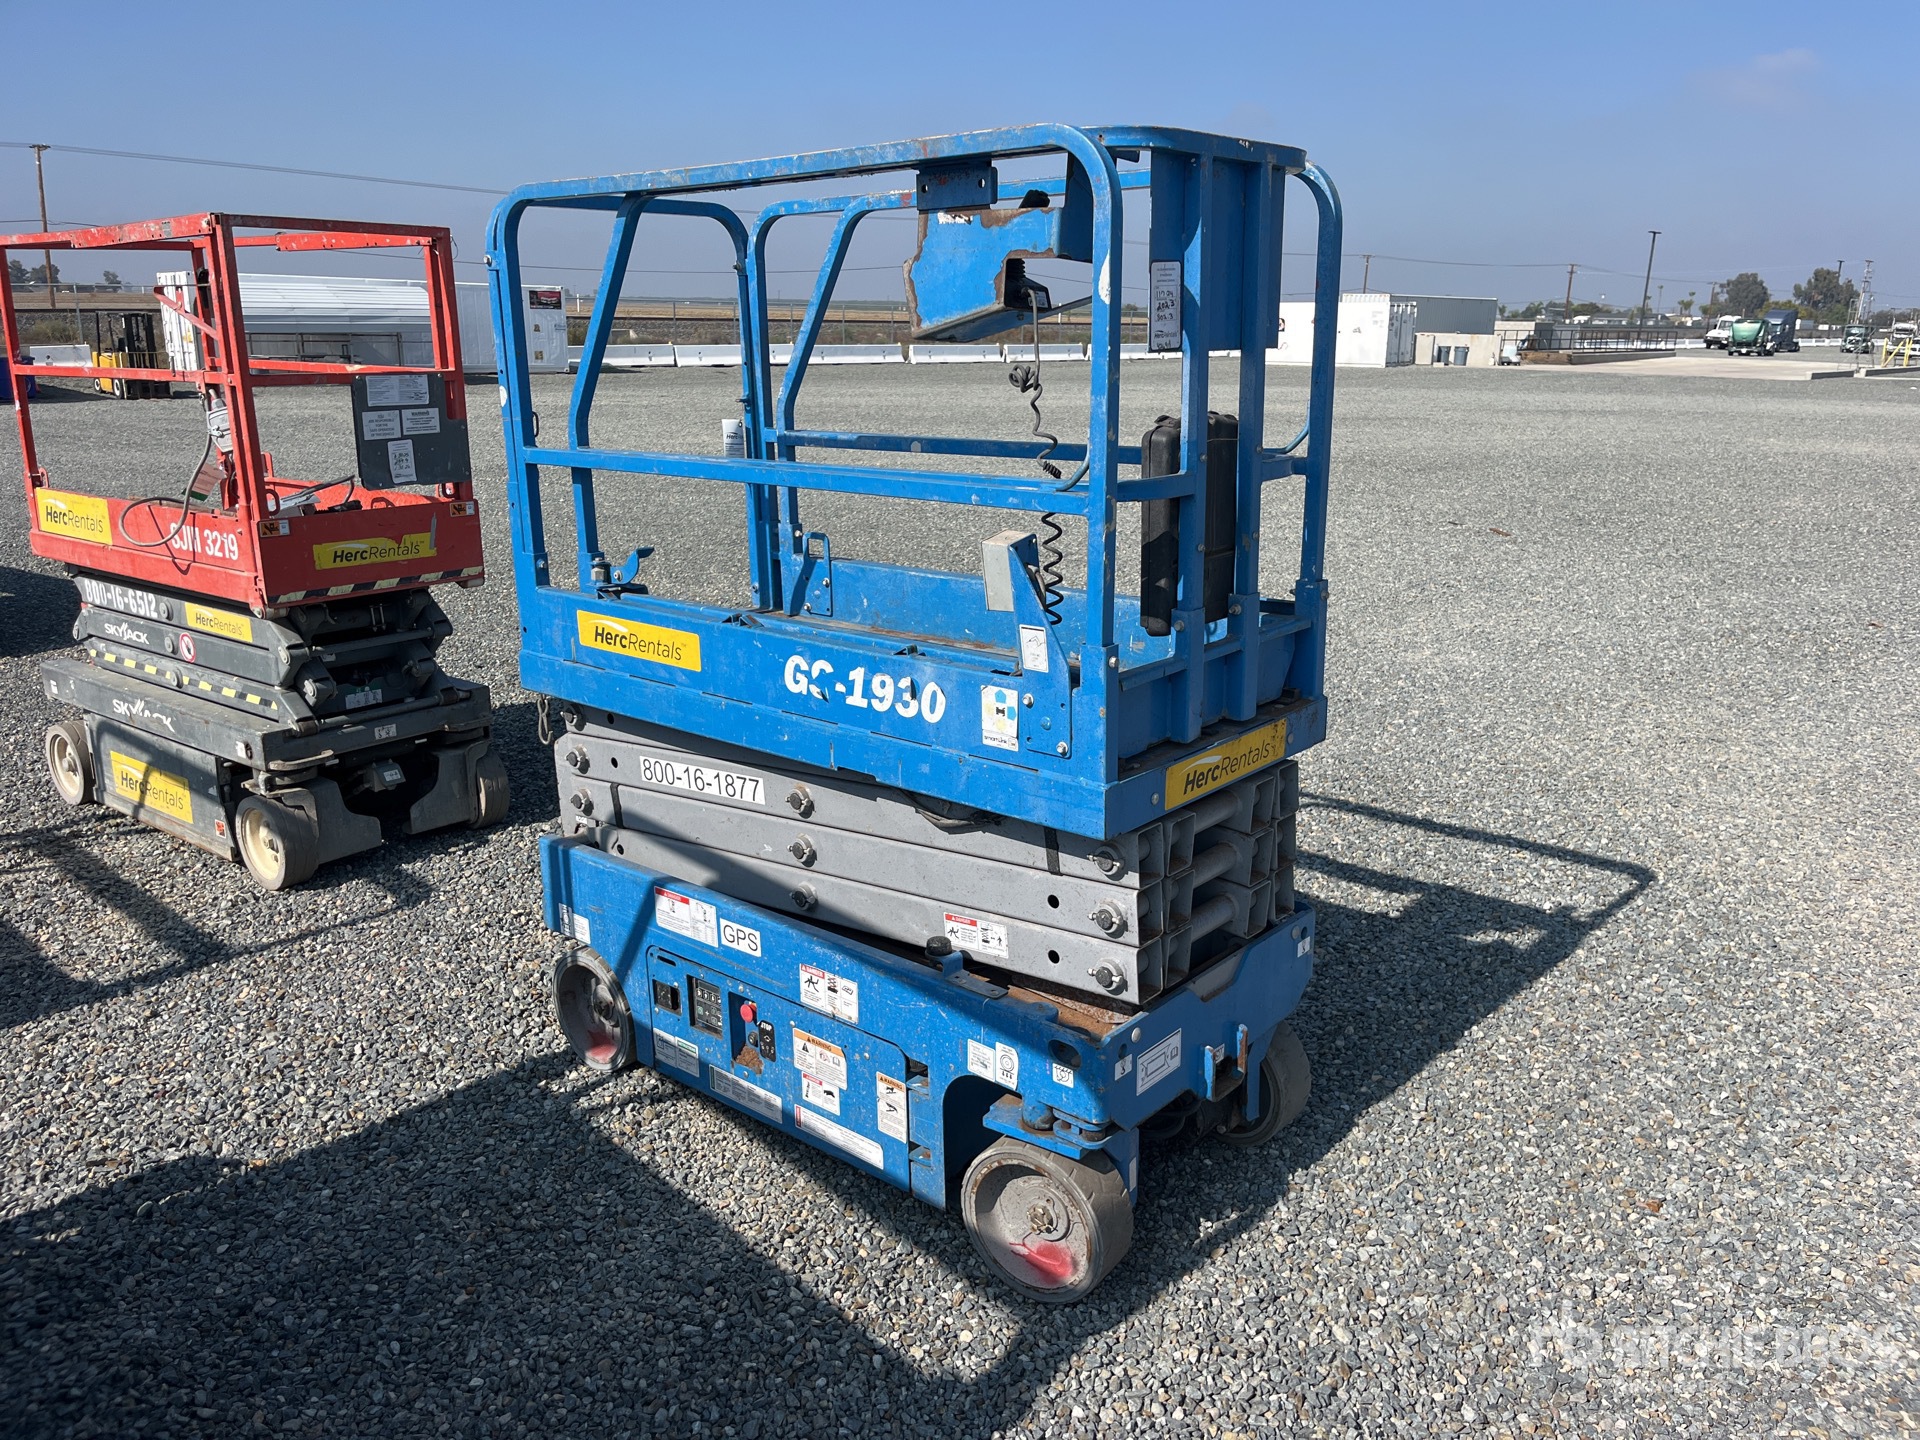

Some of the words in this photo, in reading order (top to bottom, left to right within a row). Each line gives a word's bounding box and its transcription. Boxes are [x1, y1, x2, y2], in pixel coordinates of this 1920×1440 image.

[45, 505, 104, 533] HercRentals
[203, 529, 239, 561] 3219
[332, 542, 420, 564] HercRentals
[84, 579, 158, 618] 800-16-6512
[104, 621, 150, 645] SKYJACK
[195, 612, 243, 636] HercRentals
[594, 625, 682, 661] HercRentals
[642, 758, 760, 802] 800-16-1877
[1183, 739, 1271, 795] HercRentals
[120, 770, 184, 810] HercRentals
[723, 924, 758, 952] GPS
[760, 1021, 773, 1032] STOP
[811, 1037, 832, 1052] WARNING
[884, 1078, 903, 1090] WARNING
